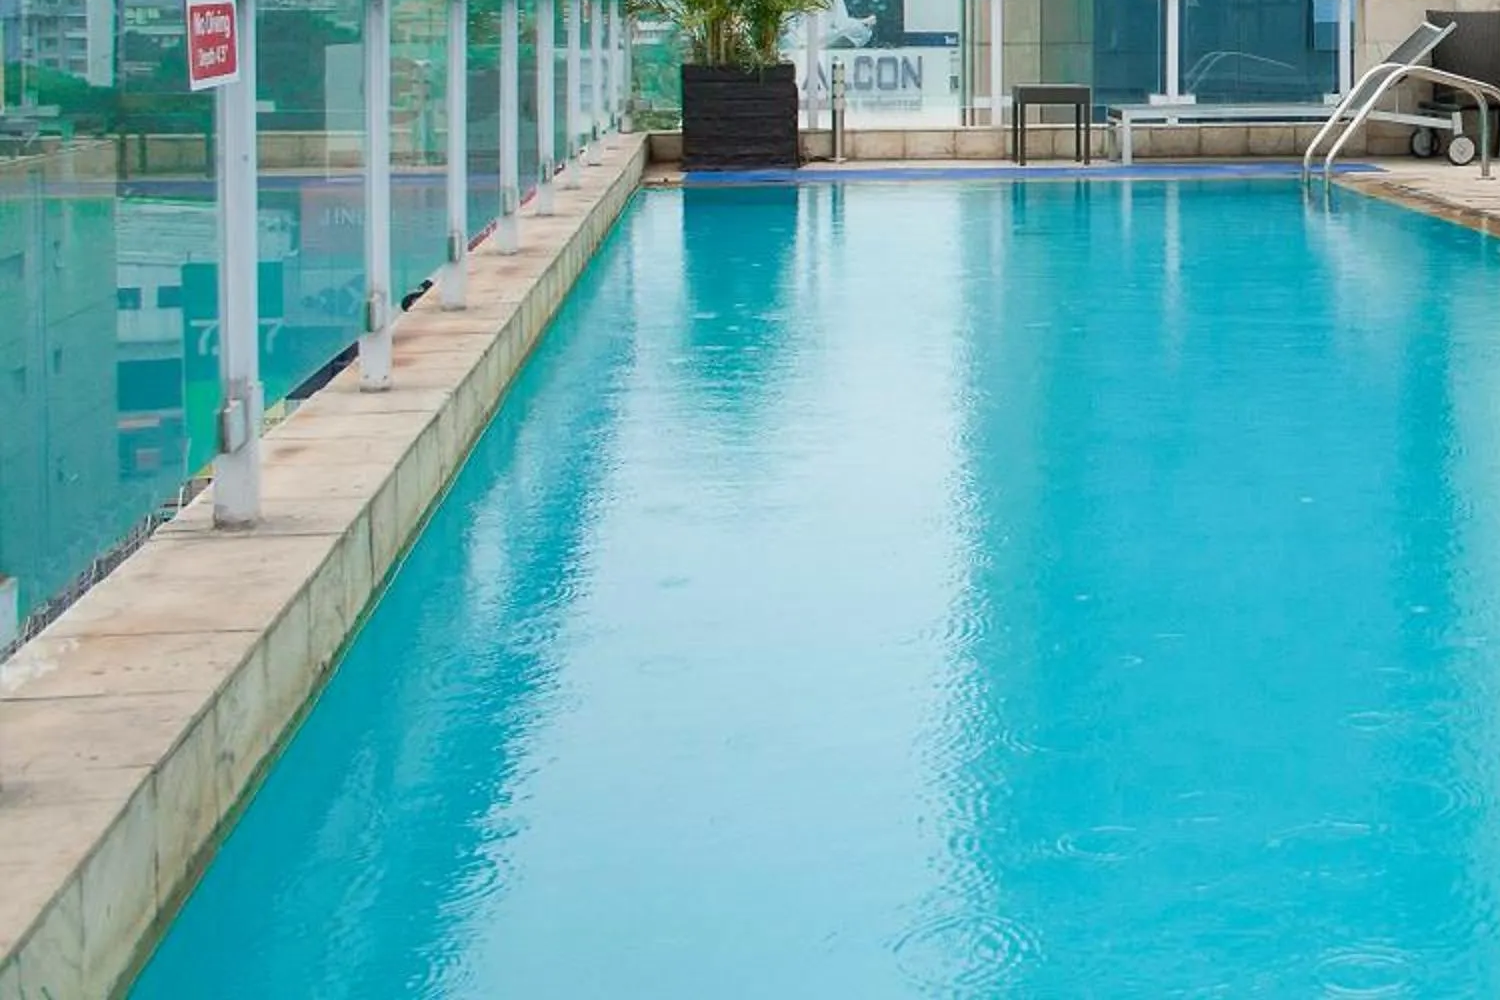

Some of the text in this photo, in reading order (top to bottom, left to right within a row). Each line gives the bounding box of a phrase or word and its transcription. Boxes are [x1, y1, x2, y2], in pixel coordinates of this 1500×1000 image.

[193, 10, 231, 39] No Diving
[801, 55, 922, 91] ACON
